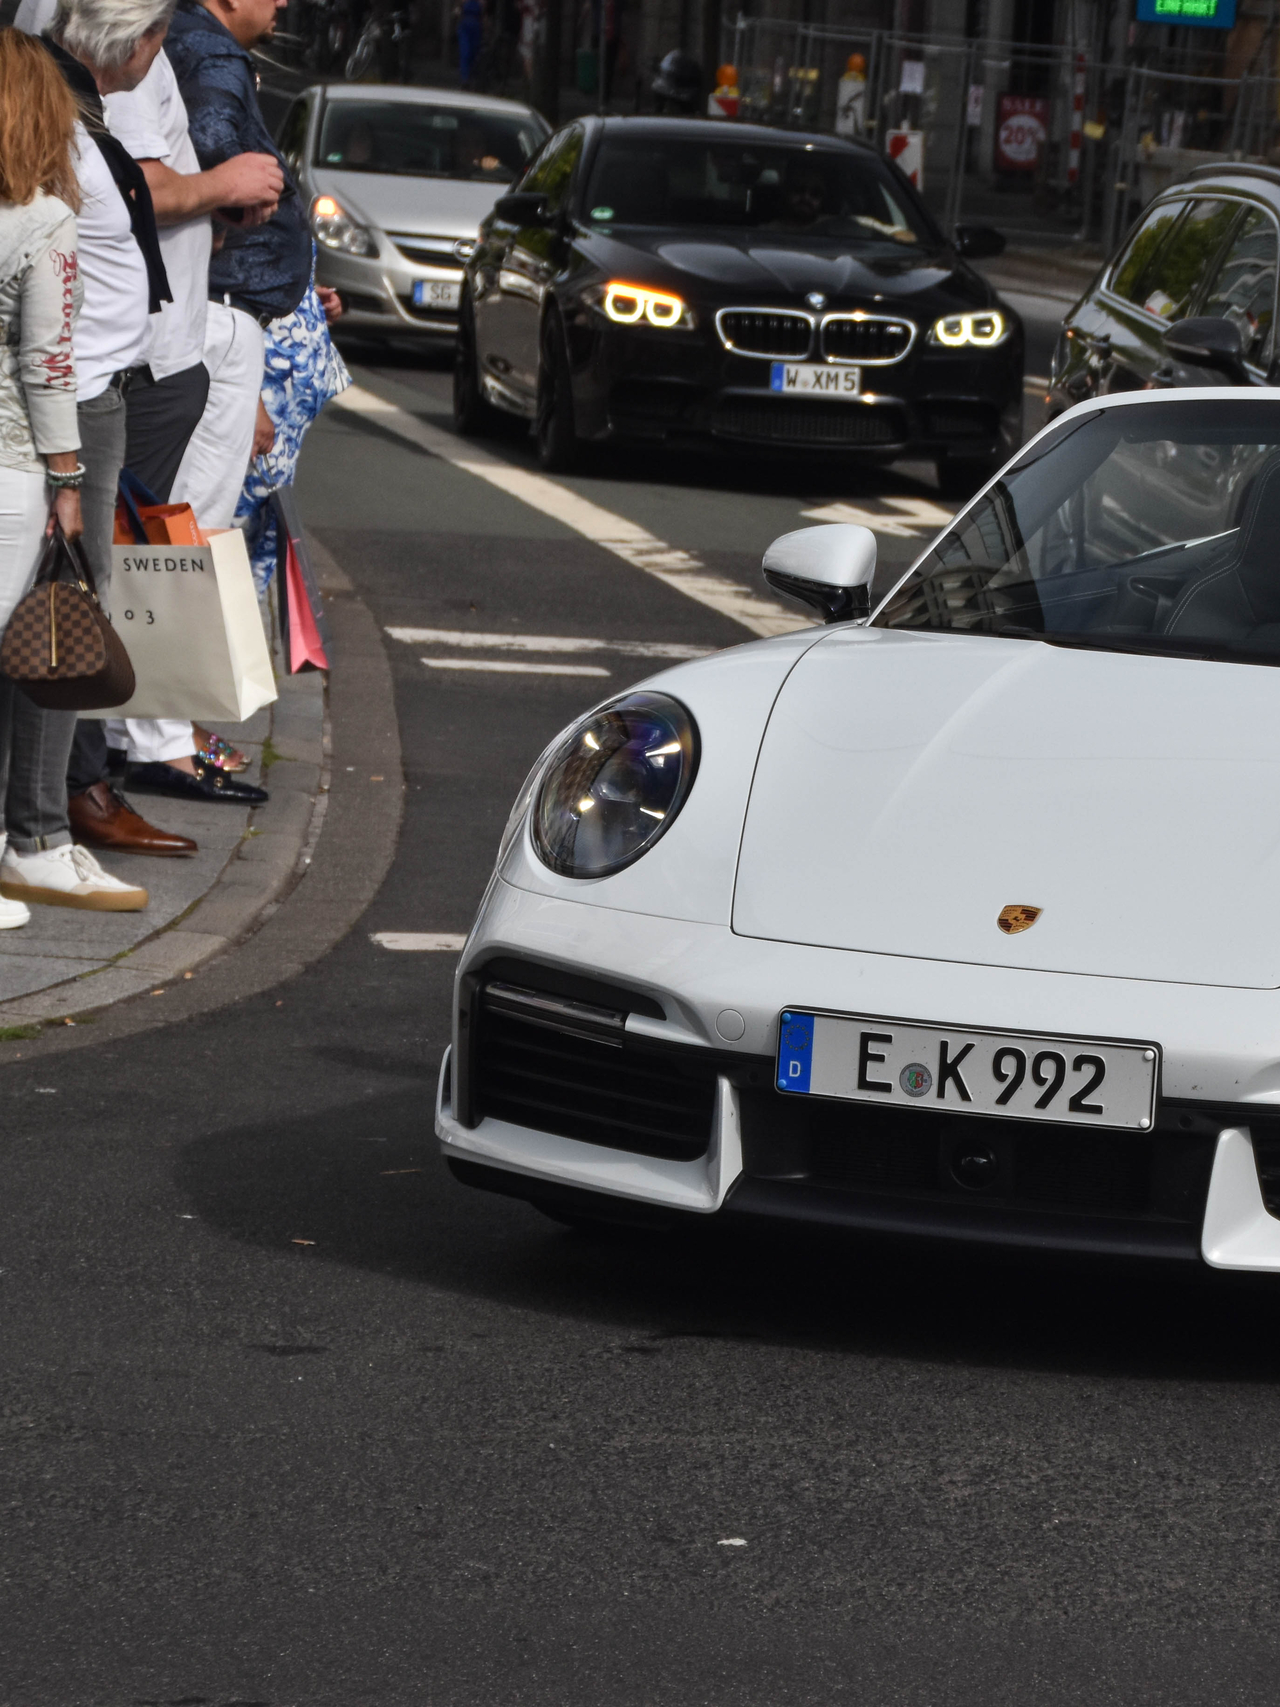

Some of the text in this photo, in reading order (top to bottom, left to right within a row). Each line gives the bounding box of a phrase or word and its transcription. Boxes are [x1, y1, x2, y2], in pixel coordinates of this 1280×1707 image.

[430, 282, 452, 301] SG
[785, 367, 798, 388] W
[123, 557, 205, 572] SWEDEN
[788, 1060, 802, 1078] D
[857, 1030, 895, 1094] E
[936, 1038, 977, 1102] K
[991, 1046, 1107, 1115] 992
